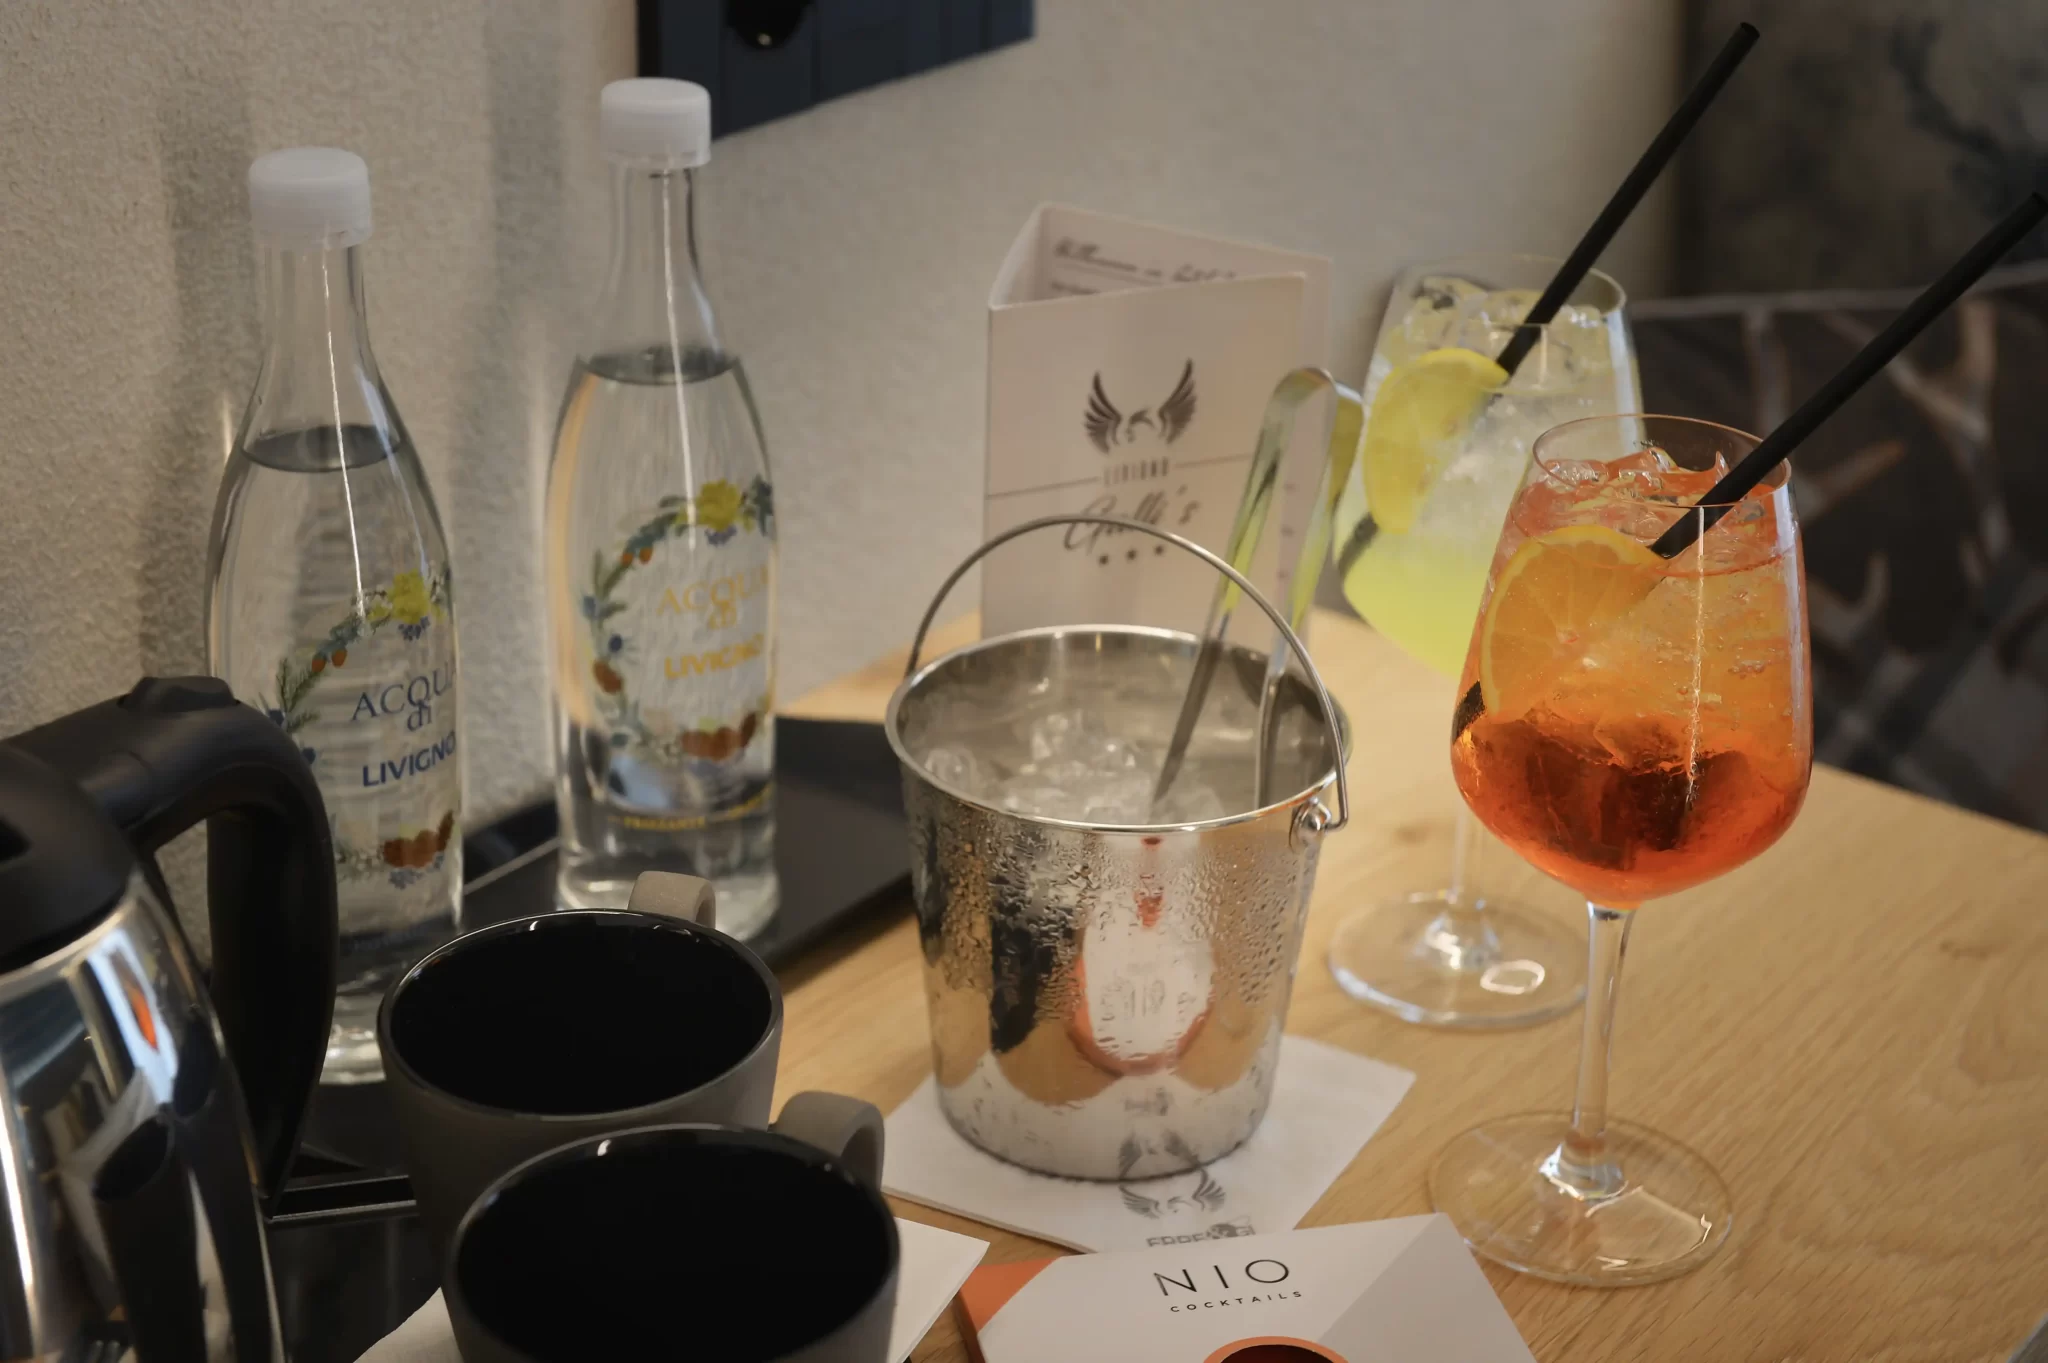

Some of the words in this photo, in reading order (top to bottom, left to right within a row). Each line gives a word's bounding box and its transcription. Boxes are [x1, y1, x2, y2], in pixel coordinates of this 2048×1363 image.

[352, 660, 456, 721] ACQU
[406, 698, 432, 731] di
[1153, 1259, 1290, 1296] NIO
[1170, 1291, 1302, 1313] COCKTAILS
